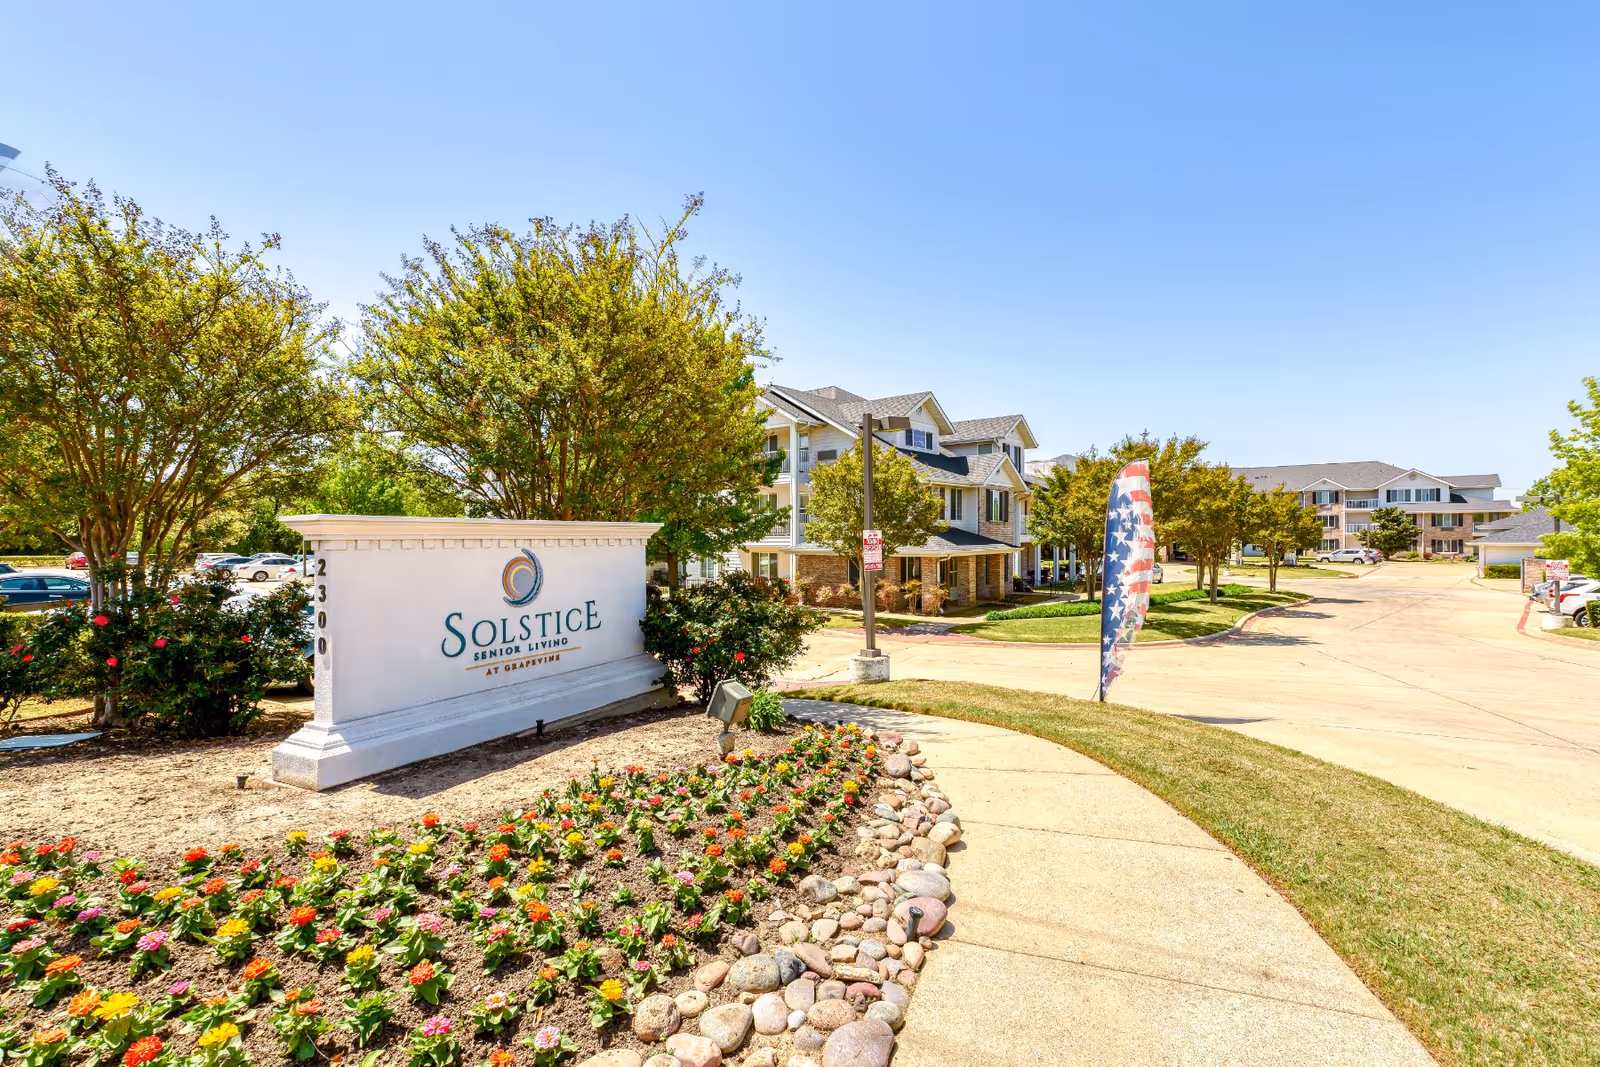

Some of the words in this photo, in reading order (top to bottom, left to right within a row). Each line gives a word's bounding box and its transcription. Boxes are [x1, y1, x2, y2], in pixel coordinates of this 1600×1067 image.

[318, 559, 327, 654] 2300
[441, 600, 602, 658] SOLSTICE
[474, 645, 521, 661] SENIOR
[528, 637, 569, 652] LIVING
[486, 667, 500, 676] AT
[504, 654, 561, 672] GRAPEVINE
